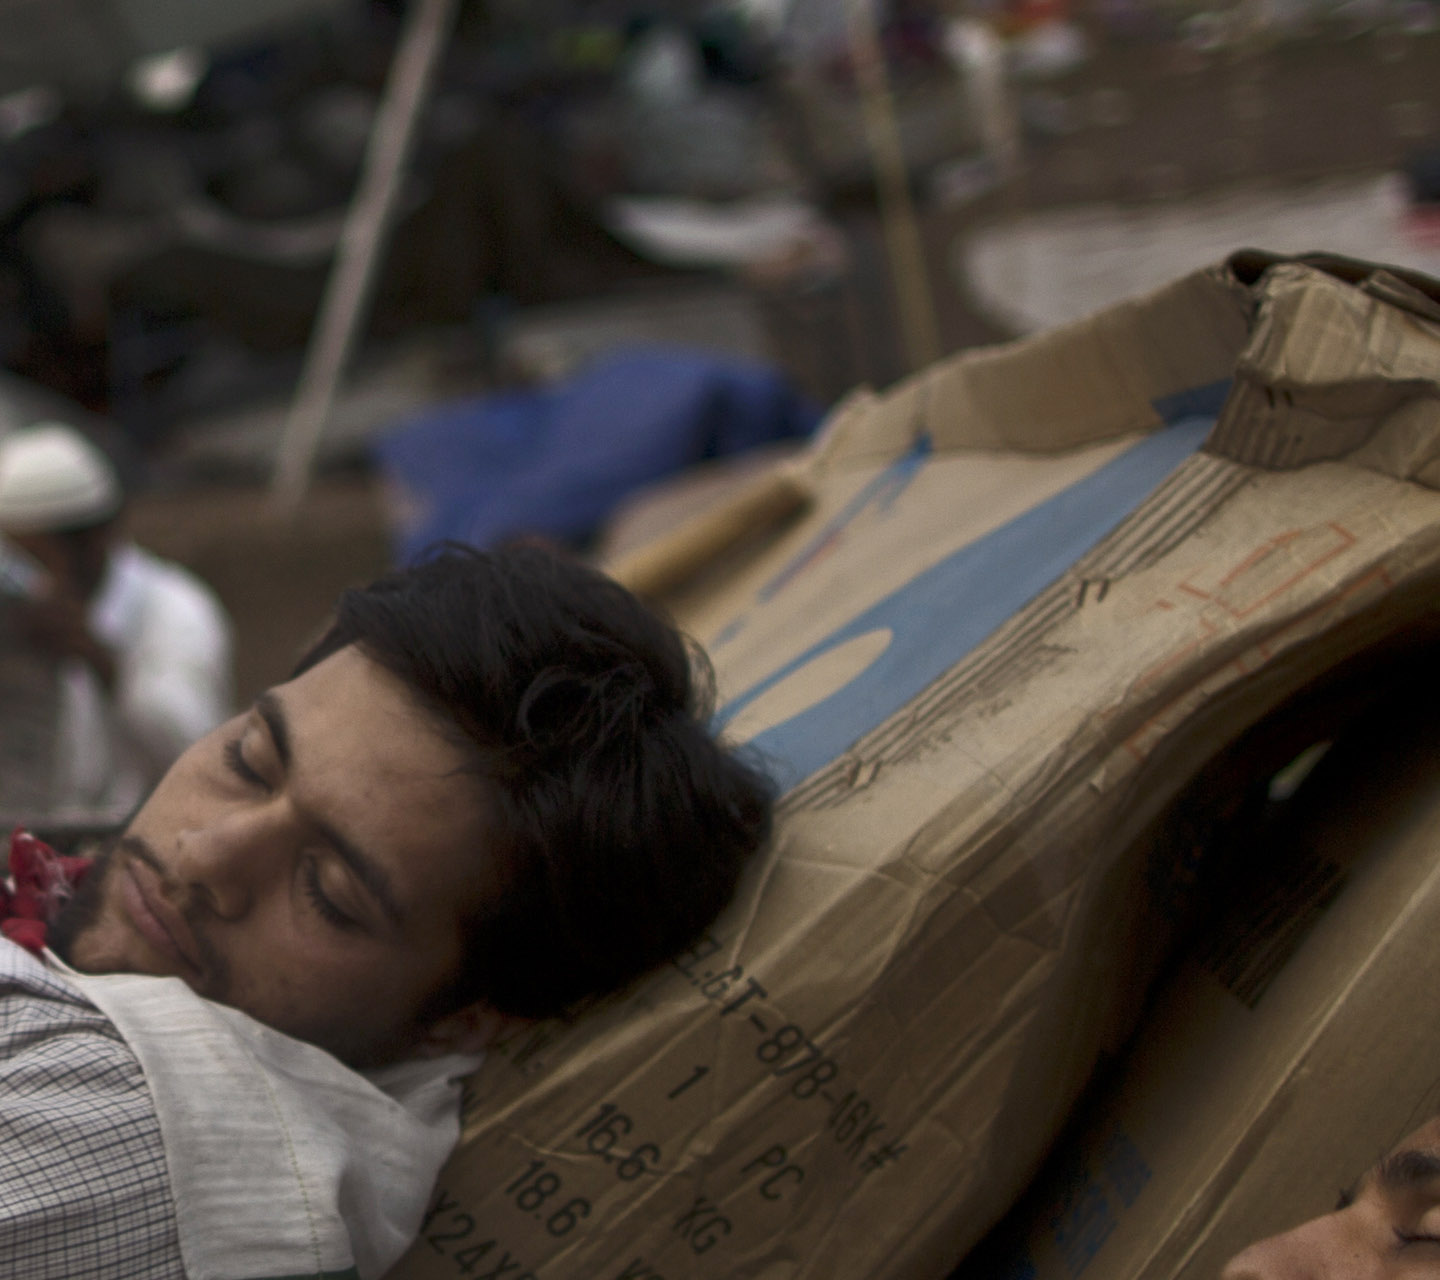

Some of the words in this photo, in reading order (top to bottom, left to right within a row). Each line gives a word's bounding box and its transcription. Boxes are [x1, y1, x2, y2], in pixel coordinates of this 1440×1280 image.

[505, 1160, 590, 1237] 18.6
[576, 1103, 661, 1182] 16.6
[672, 1197, 732, 1254] KG
[668, 1066, 708, 1100] 1
[742, 1145, 804, 1201] PC
